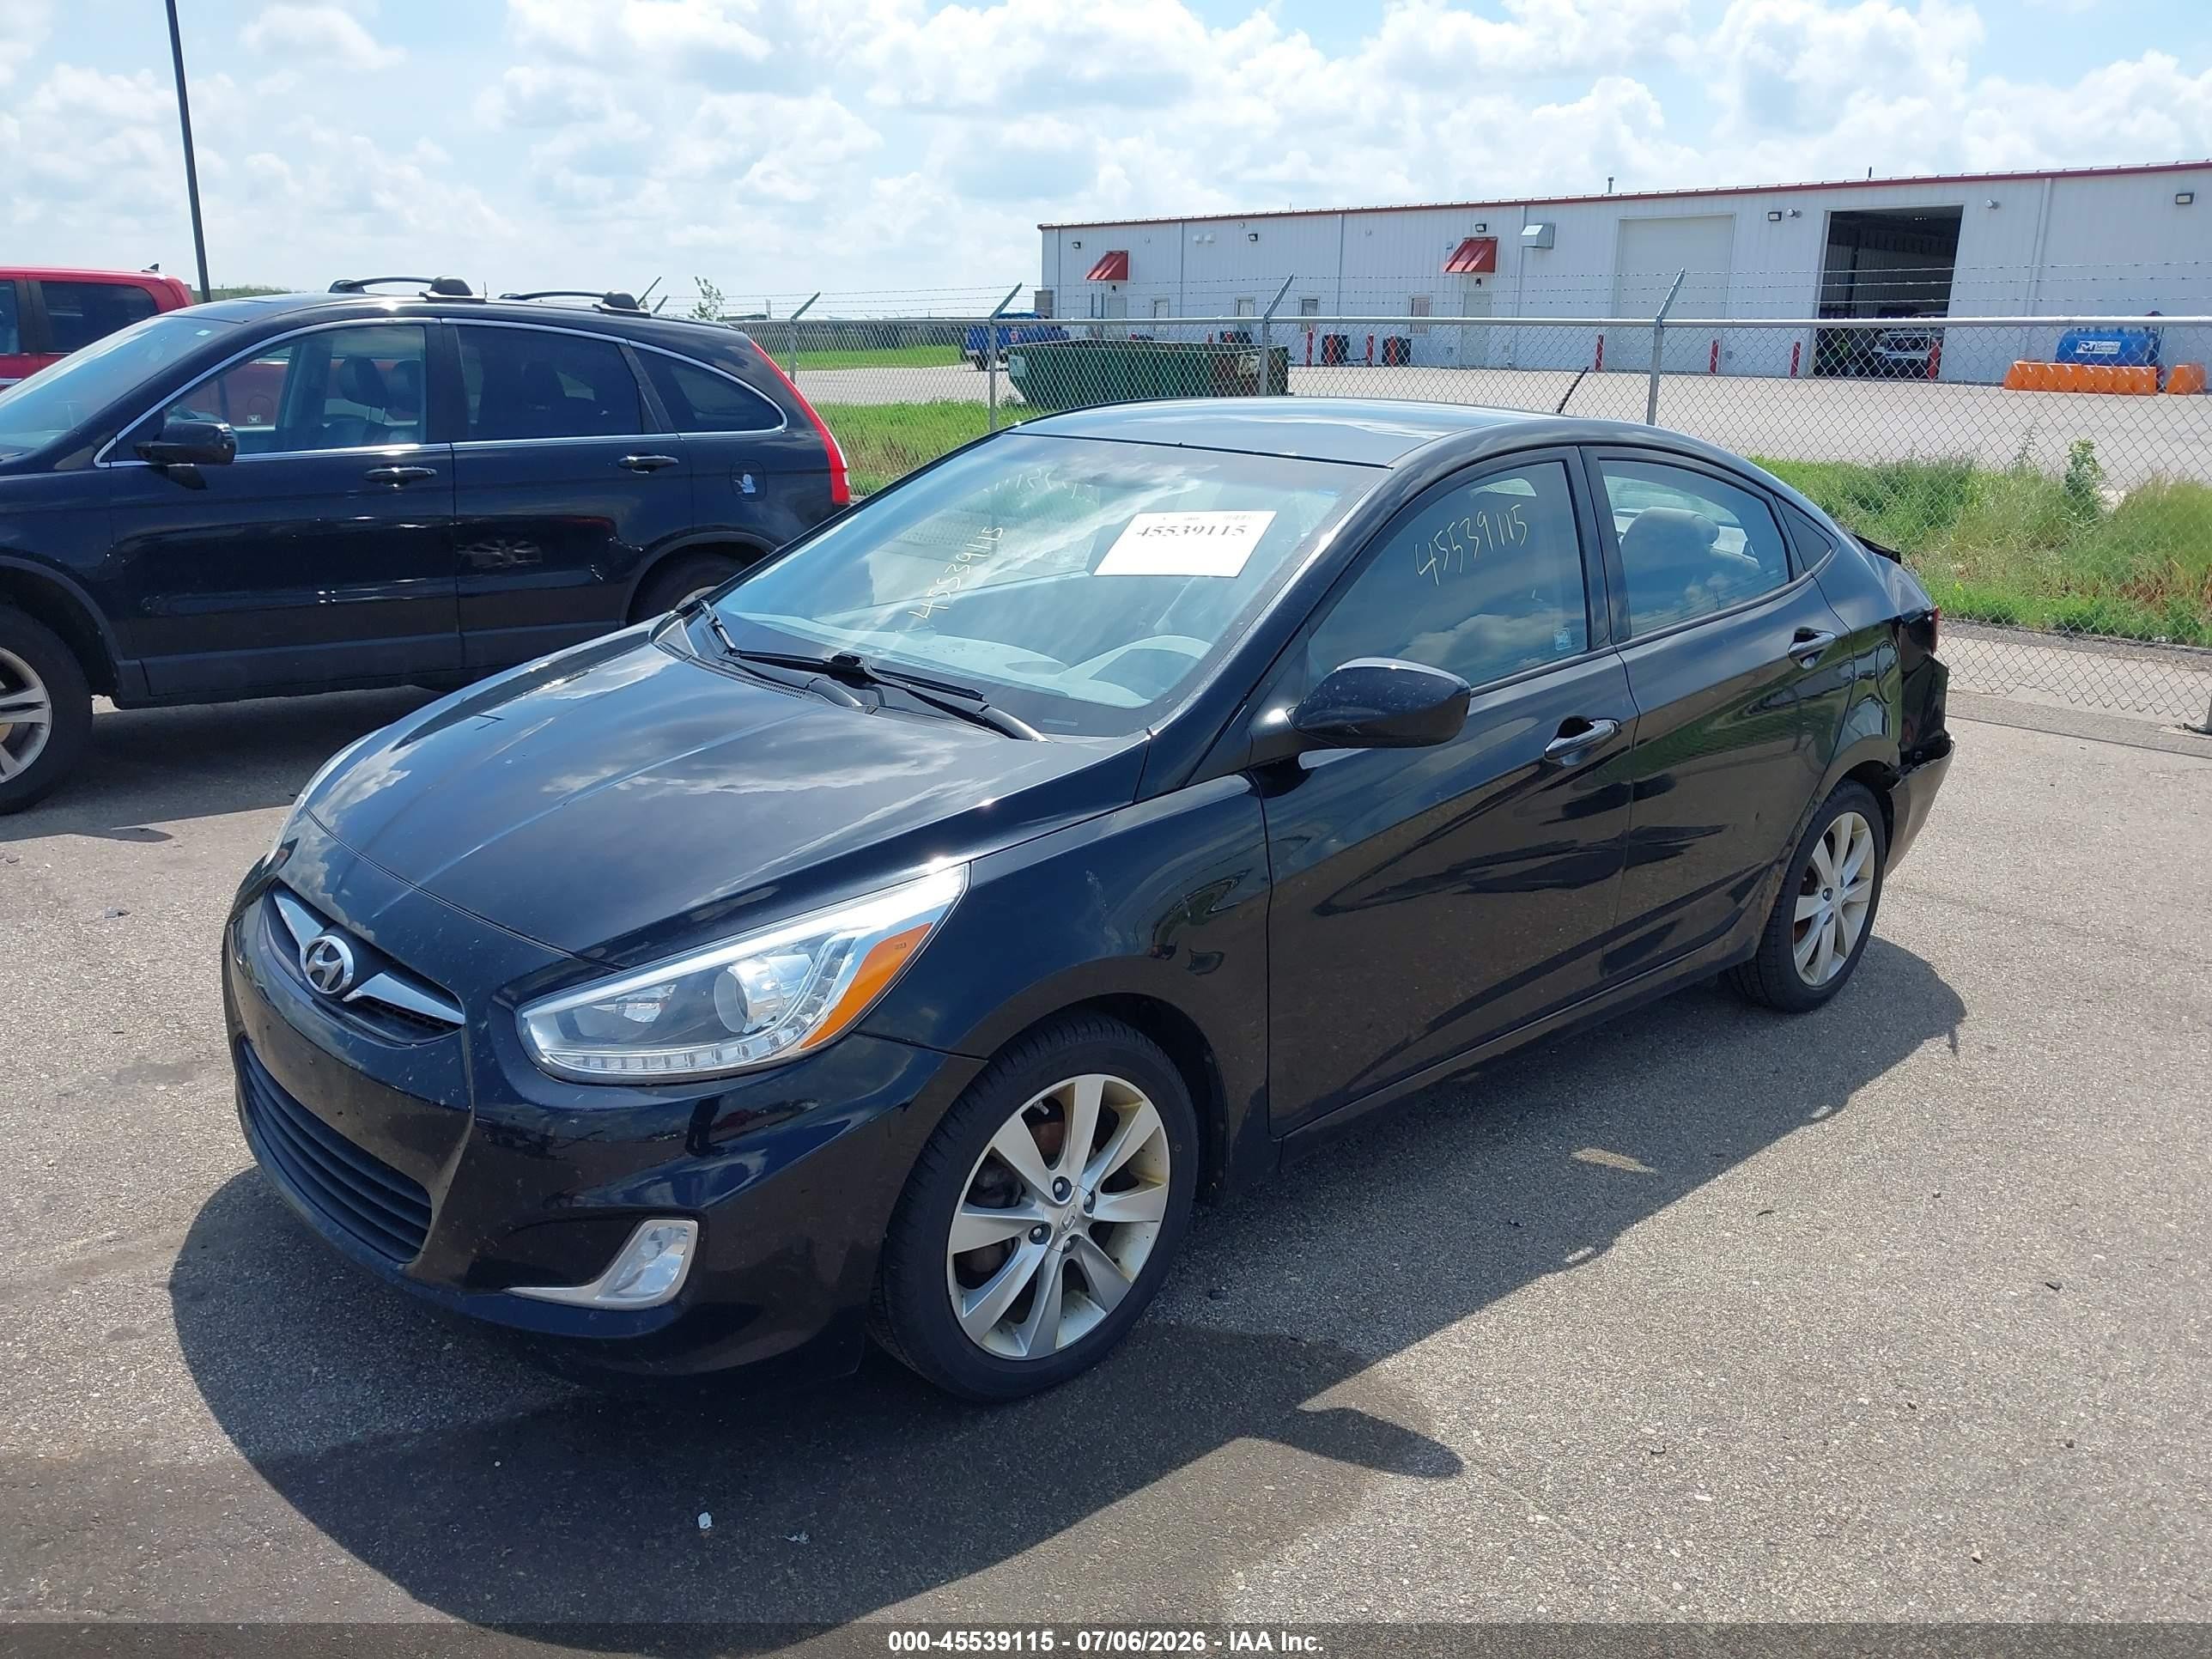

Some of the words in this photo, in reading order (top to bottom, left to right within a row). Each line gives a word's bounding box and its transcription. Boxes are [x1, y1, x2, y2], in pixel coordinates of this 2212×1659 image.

[908, 526, 1003, 619] 45539115
[1136, 525, 1248, 538] 45539115
[1414, 504, 1528, 586] 45539115
